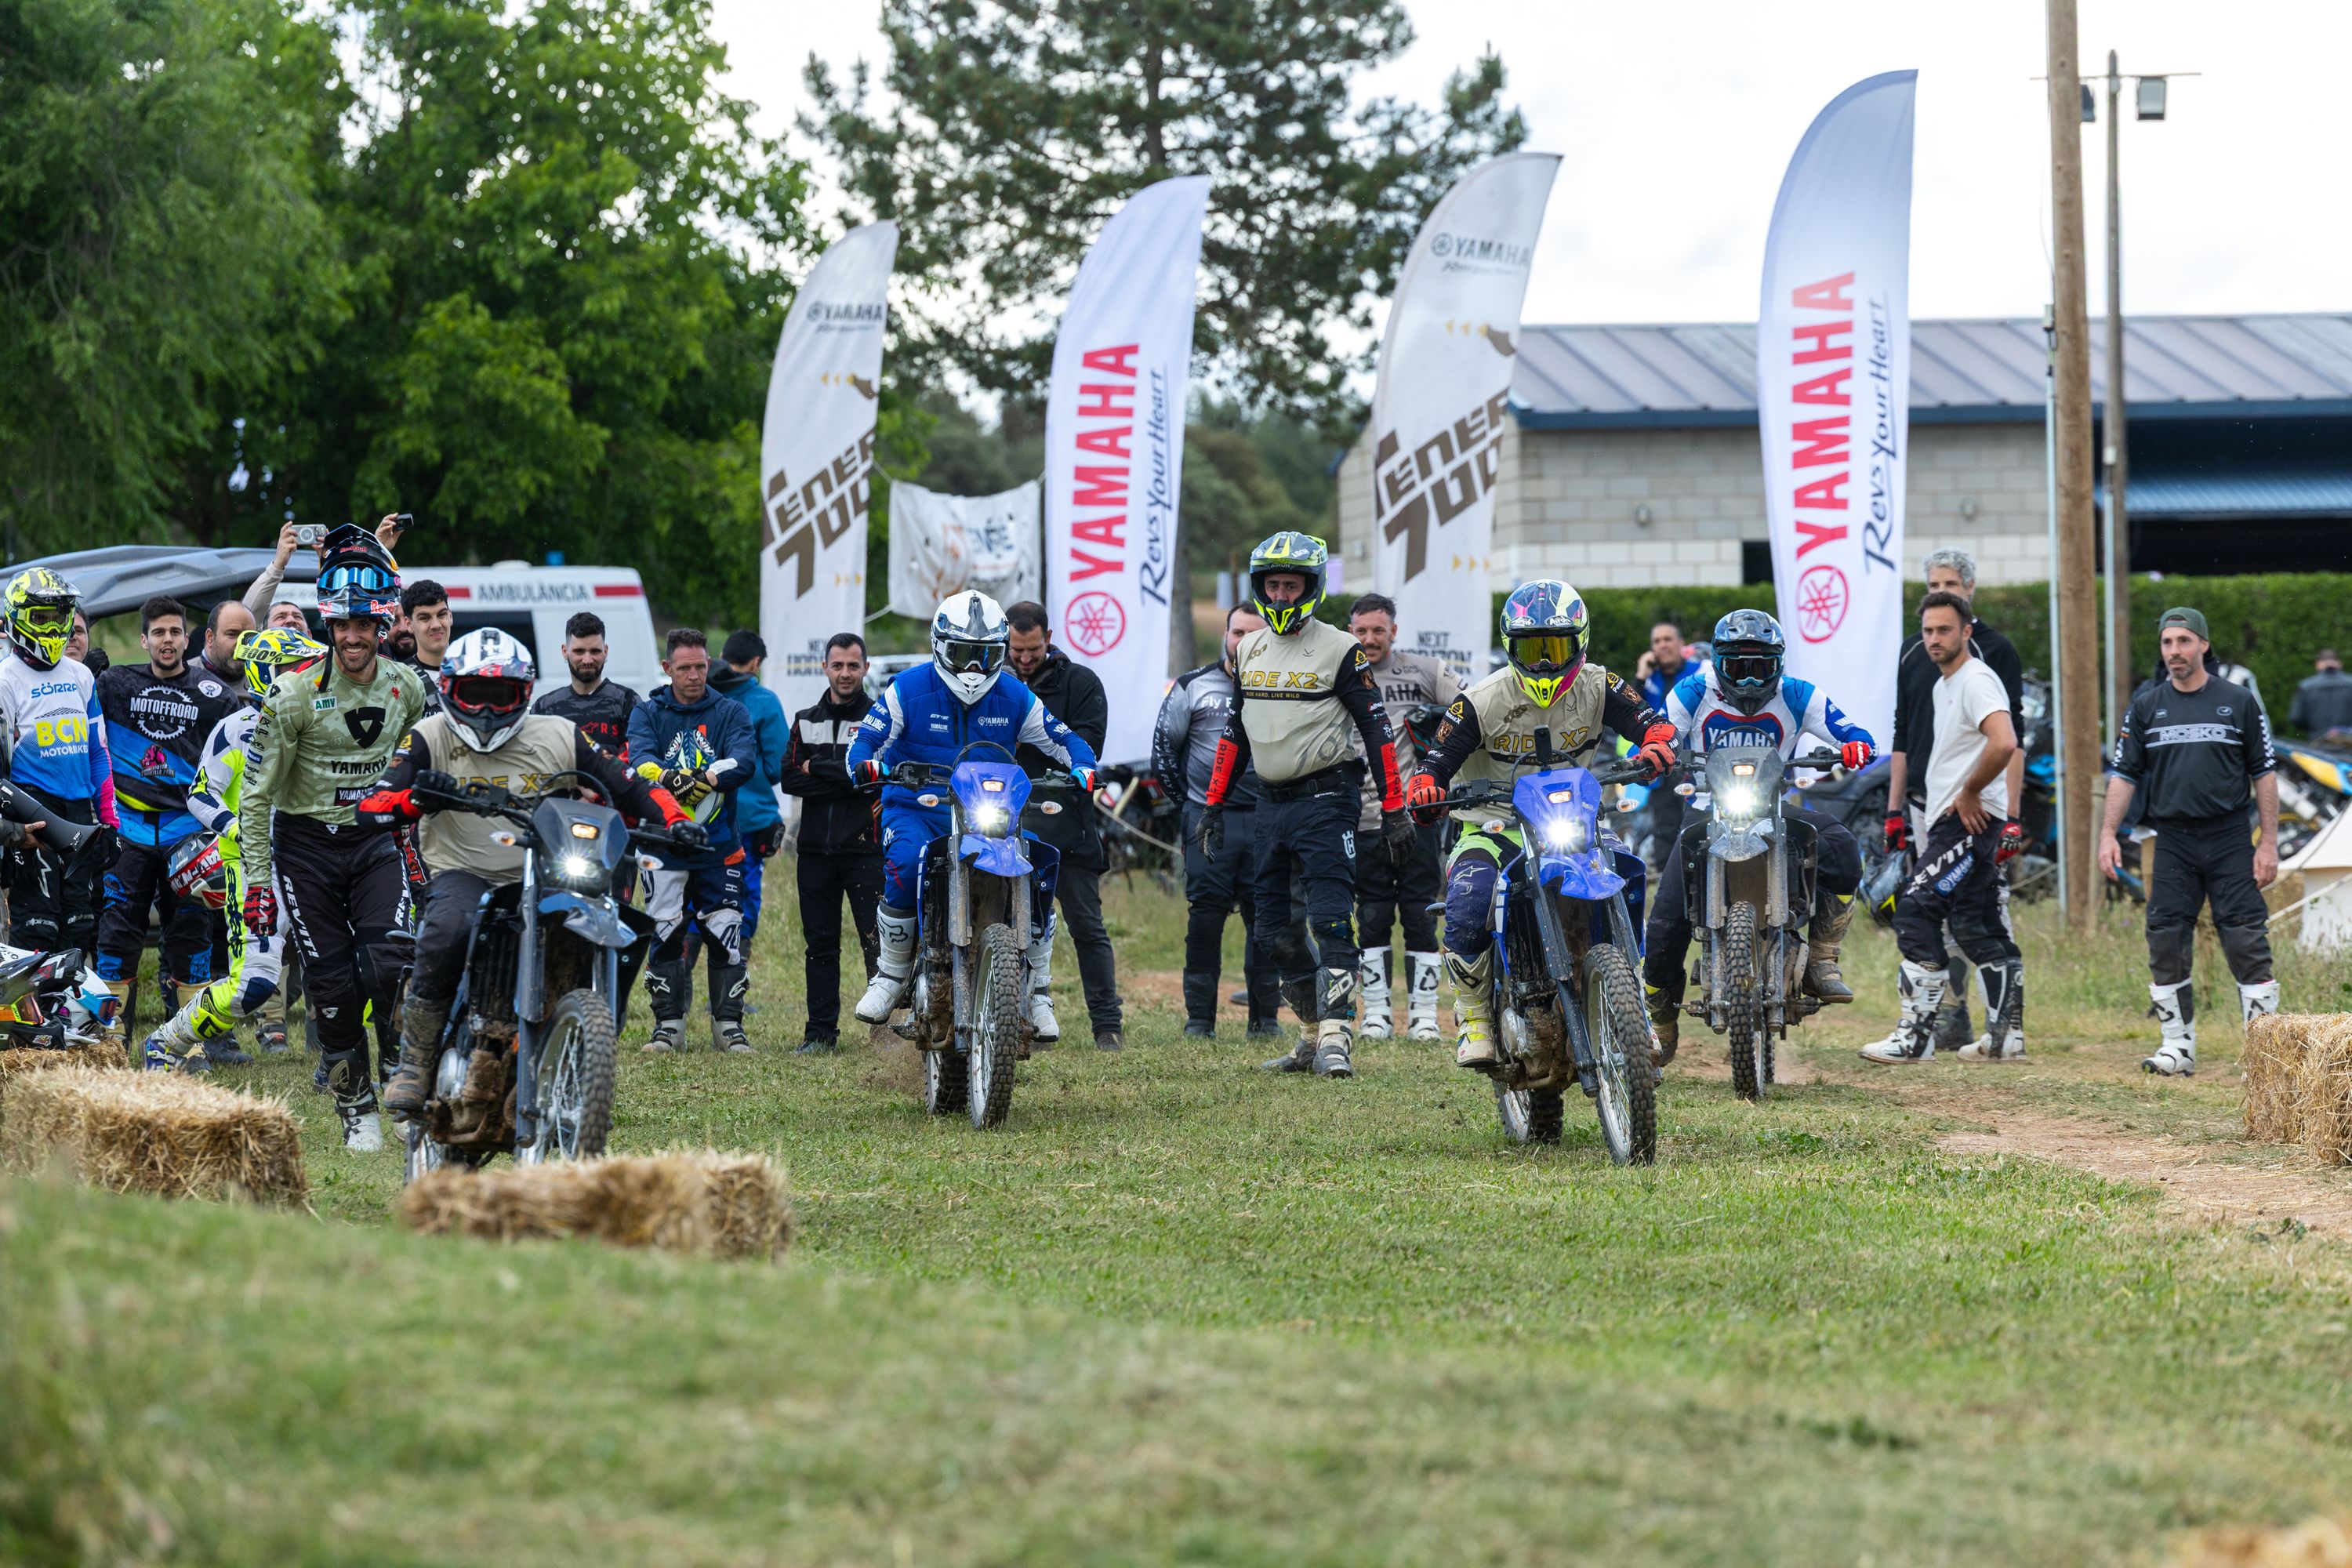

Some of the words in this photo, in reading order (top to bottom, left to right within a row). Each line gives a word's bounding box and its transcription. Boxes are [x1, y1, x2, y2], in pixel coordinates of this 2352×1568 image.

[1456, 237, 1529, 267] YAMAHA
[823, 303, 882, 321] YAMAHA
[1868, 296, 1890, 383] Heart
[1146, 368, 1165, 444] Heart
[1791, 271, 1856, 561] YAMAHA
[1871, 385, 1898, 459] Your
[1069, 343, 1140, 583] YAMAHA
[1146, 445, 1172, 510] Your
[1863, 465, 1896, 575] Revs
[1138, 513, 1168, 607] Revs
[1549, 615, 1572, 626] Airoh
[1417, 632, 1450, 648] NEXT
[1284, 672, 1319, 690] X2
[1385, 684, 1421, 702] AHA
[130, 697, 198, 720] MOTOFFROAD
[315, 698, 336, 710] AMV
[130, 713, 196, 728] ACADEMY
[35, 717, 88, 748] BCN
[1708, 727, 1776, 748] YAMAHA
[2160, 728, 2227, 742] MOSKO
[40, 744, 89, 758] MOTORBIKES
[1494, 735, 1537, 753] RID
[674, 780, 695, 797] hebo
[1414, 777, 1422, 793] RID
[722, 869, 741, 907] SHO
